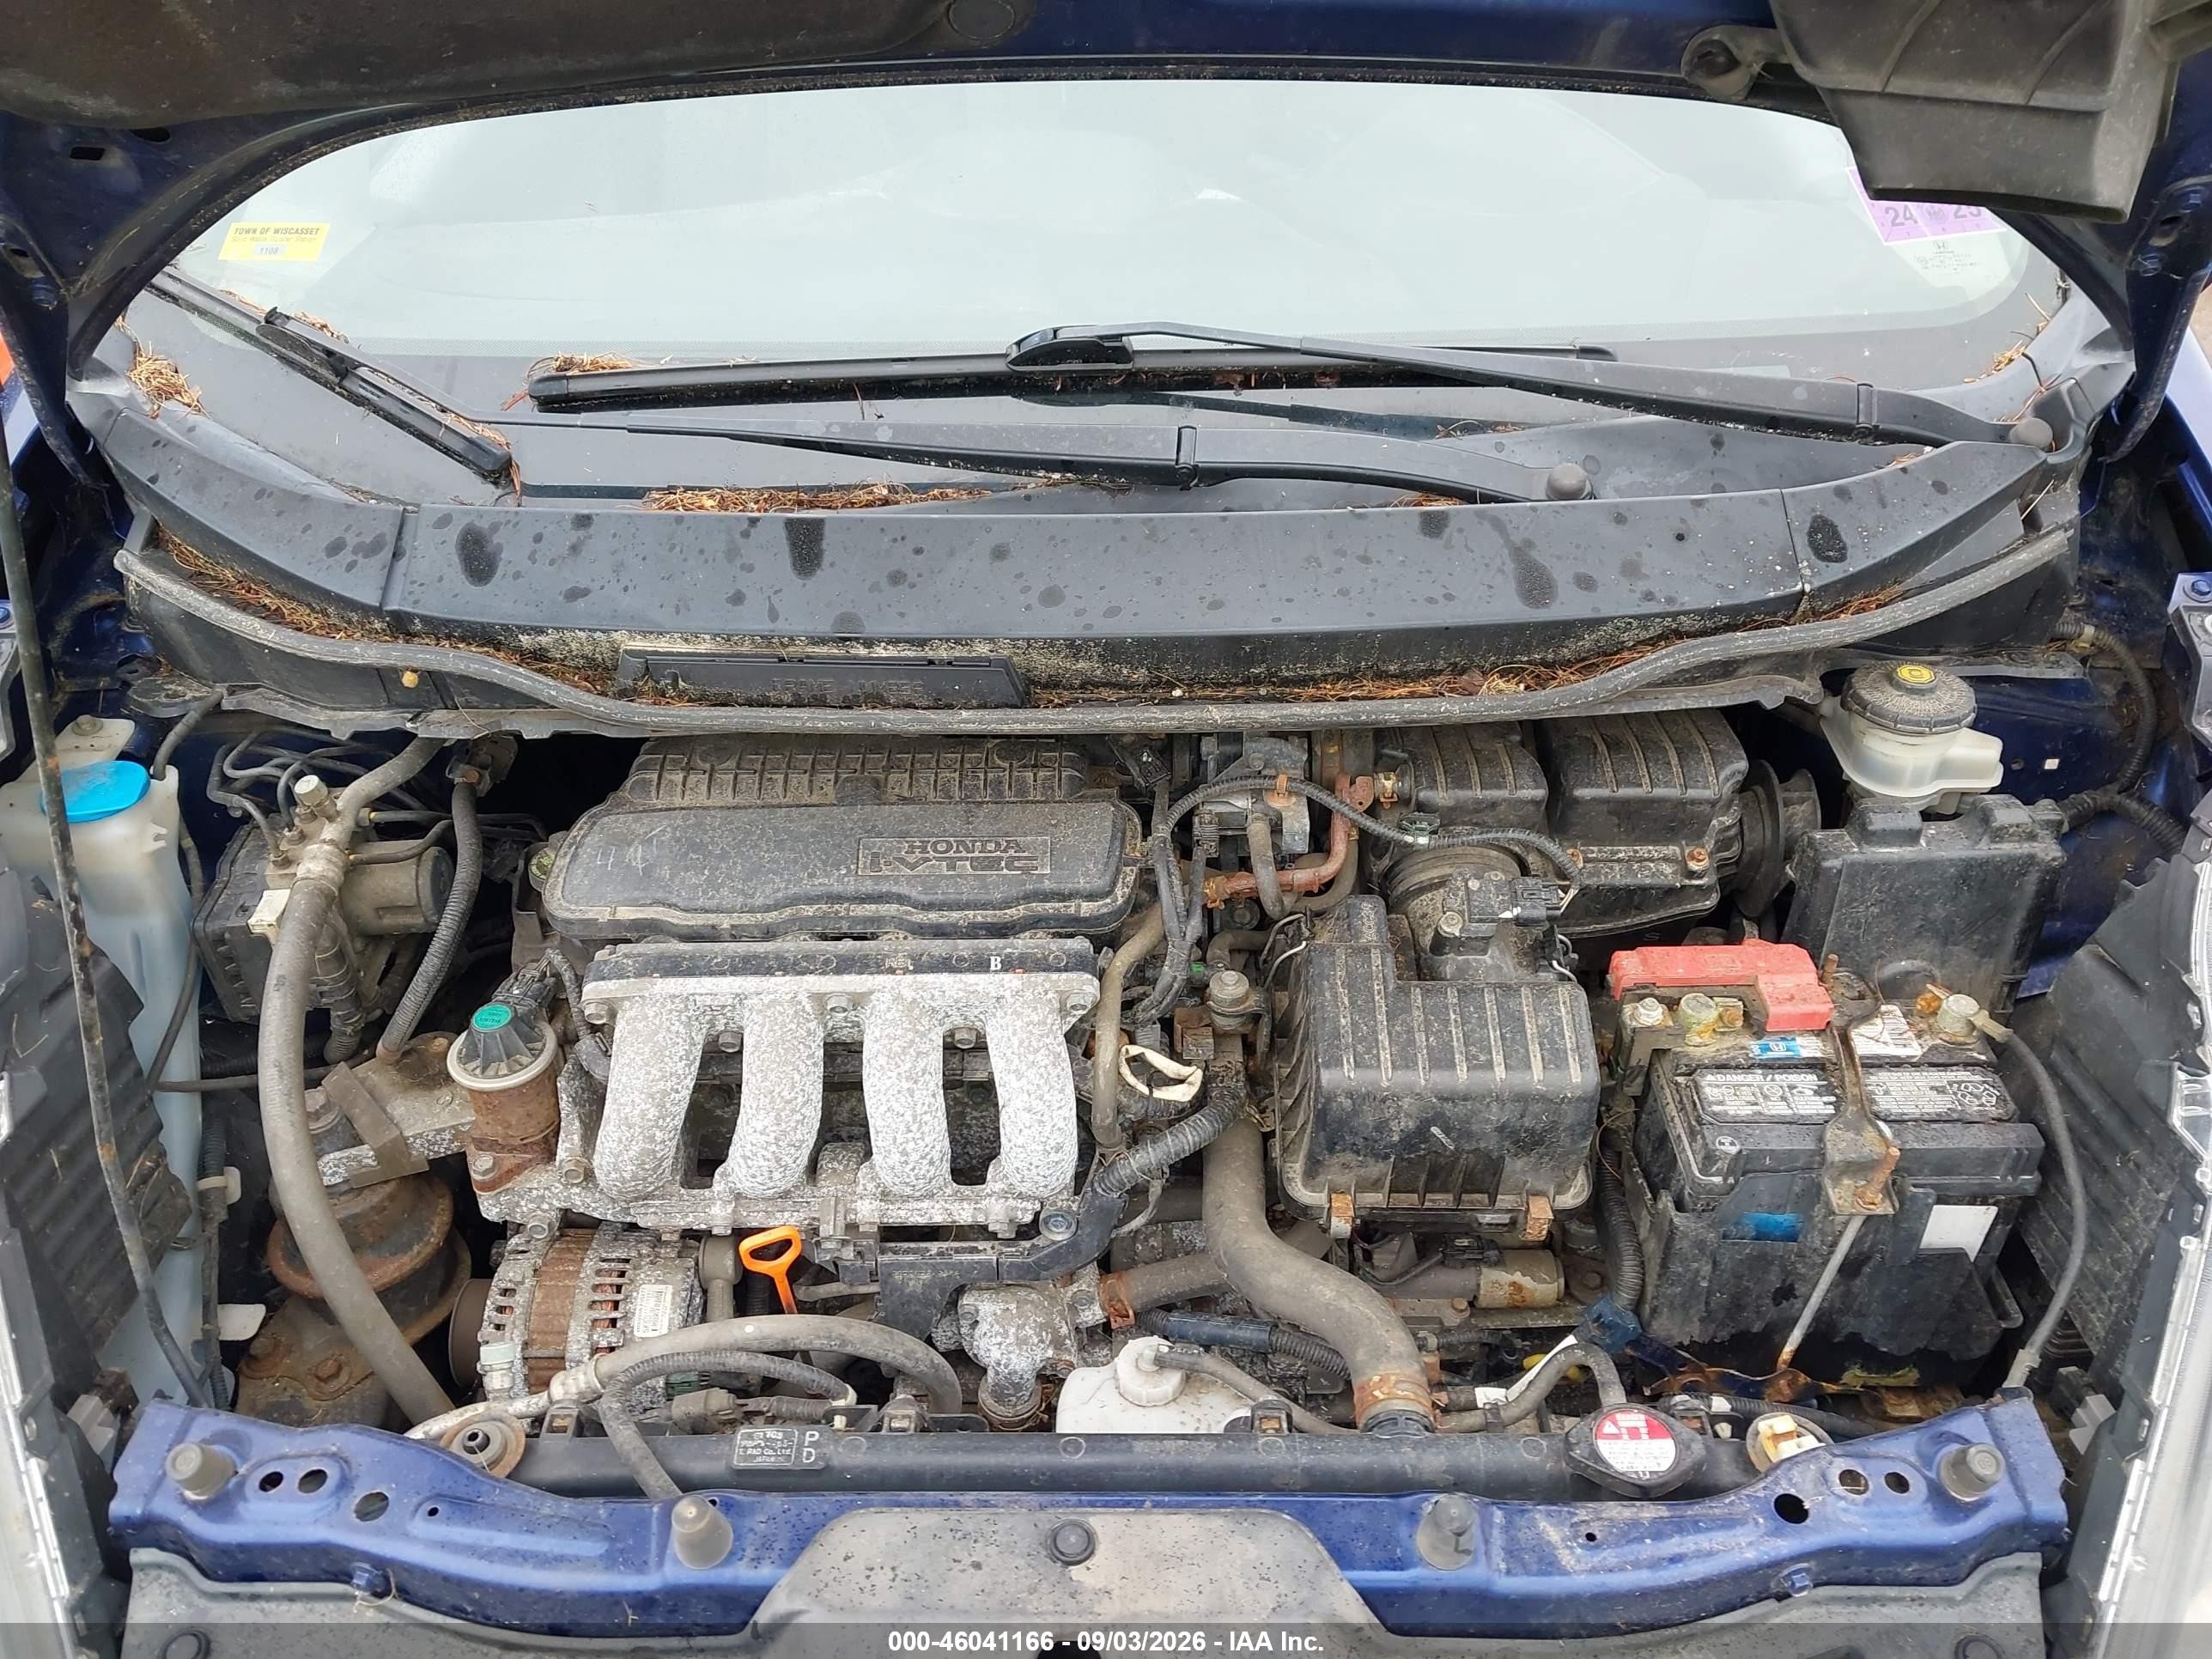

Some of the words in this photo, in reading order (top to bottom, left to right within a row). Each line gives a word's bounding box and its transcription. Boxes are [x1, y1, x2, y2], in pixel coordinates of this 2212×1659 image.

[1885, 204, 1918, 227] 24
[234, 227, 257, 235] TOWN
[259, 227, 271, 235] OF
[273, 227, 320, 235] WISCASSET
[903, 839, 1027, 854] HONDA
[869, 850, 1039, 873] i-VTEC
[989, 956, 1002, 971] B
[1717, 1073, 1765, 1082] DANGER
[1775, 1073, 1819, 1082] POISON
[803, 1431, 819, 1446] P
[802, 1448, 816, 1463] D
